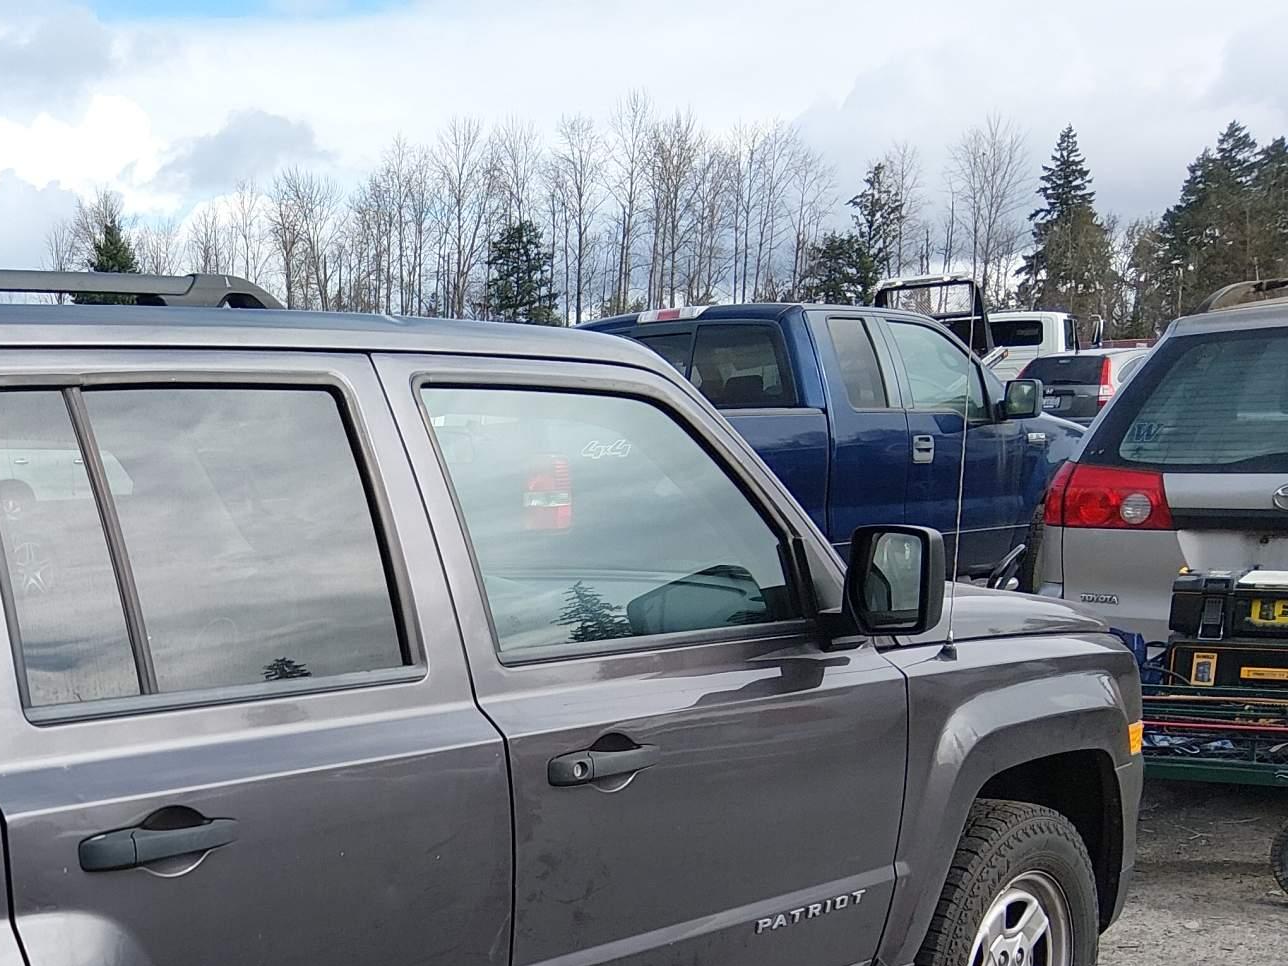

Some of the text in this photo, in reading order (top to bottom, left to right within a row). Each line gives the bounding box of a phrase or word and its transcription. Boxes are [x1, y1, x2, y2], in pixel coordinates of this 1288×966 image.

[581, 439, 632, 460] 4x4
[1080, 593, 1119, 604] TOYOTA
[755, 889, 867, 935] PATRIOT
